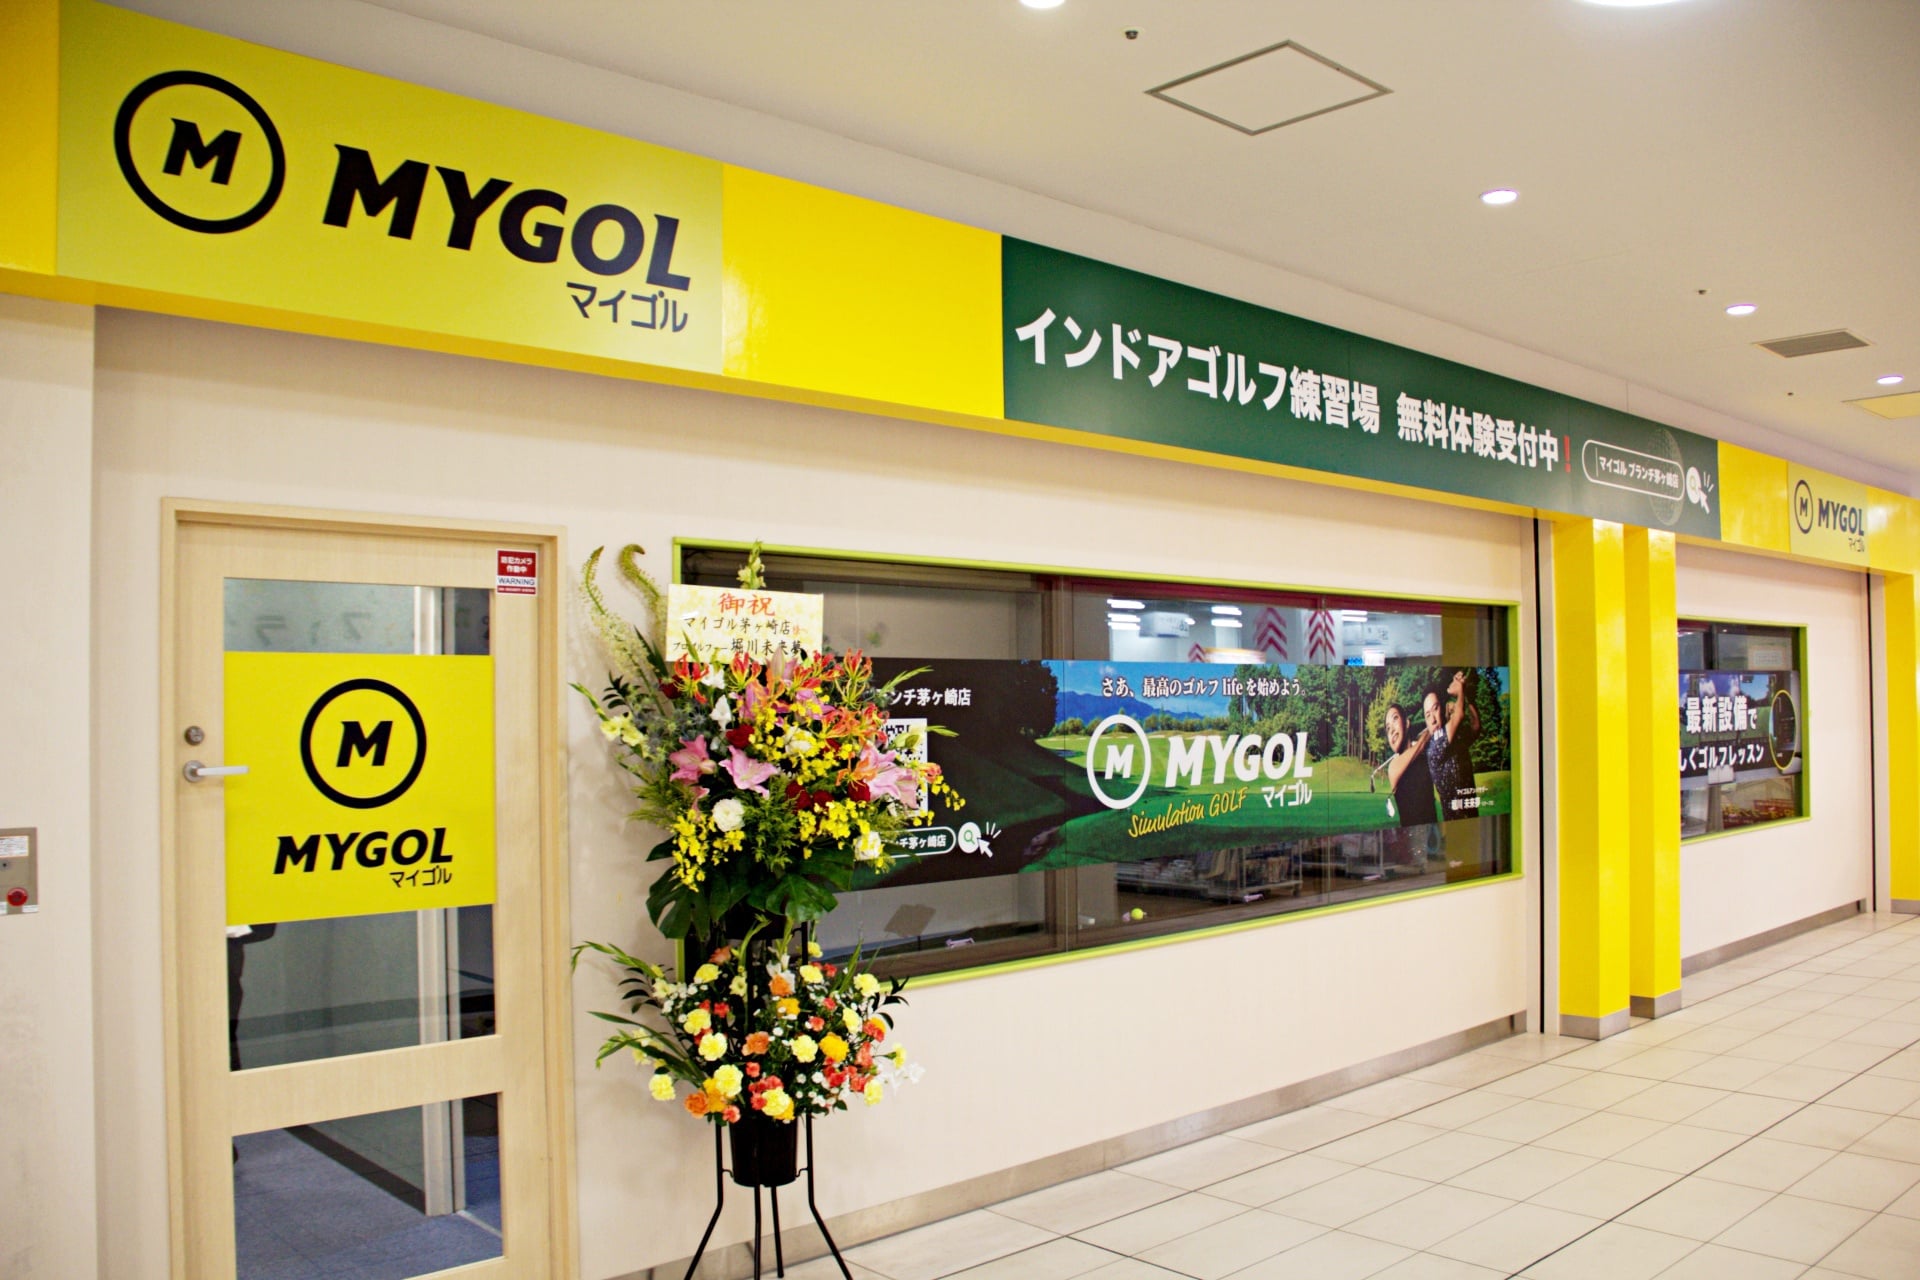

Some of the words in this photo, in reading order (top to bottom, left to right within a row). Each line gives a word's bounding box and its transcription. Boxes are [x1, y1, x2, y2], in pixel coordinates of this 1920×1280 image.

[163, 118, 242, 186] M
[322, 144, 691, 291] MYGOL
[566, 281, 689, 333] マイゴル
[1015, 307, 1380, 434] インドアゴルフ練習場
[1599, 456, 1627, 476] マイゴル
[1818, 498, 1864, 536] MYGOL
[498, 577, 535, 586] WARNING
[718, 592, 775, 616] 御祝
[1686, 695, 1758, 734] 最新設備で
[336, 720, 394, 768] M
[1104, 744, 1135, 780] M
[1165, 732, 1313, 788] MYGOL
[1128, 798, 1205, 838] Simulation
[1209, 786, 1249, 818] GOLF
[1261, 780, 1312, 808] マイゴル
[273, 827, 453, 875] MYGOL
[389, 865, 452, 888] マイゴル
